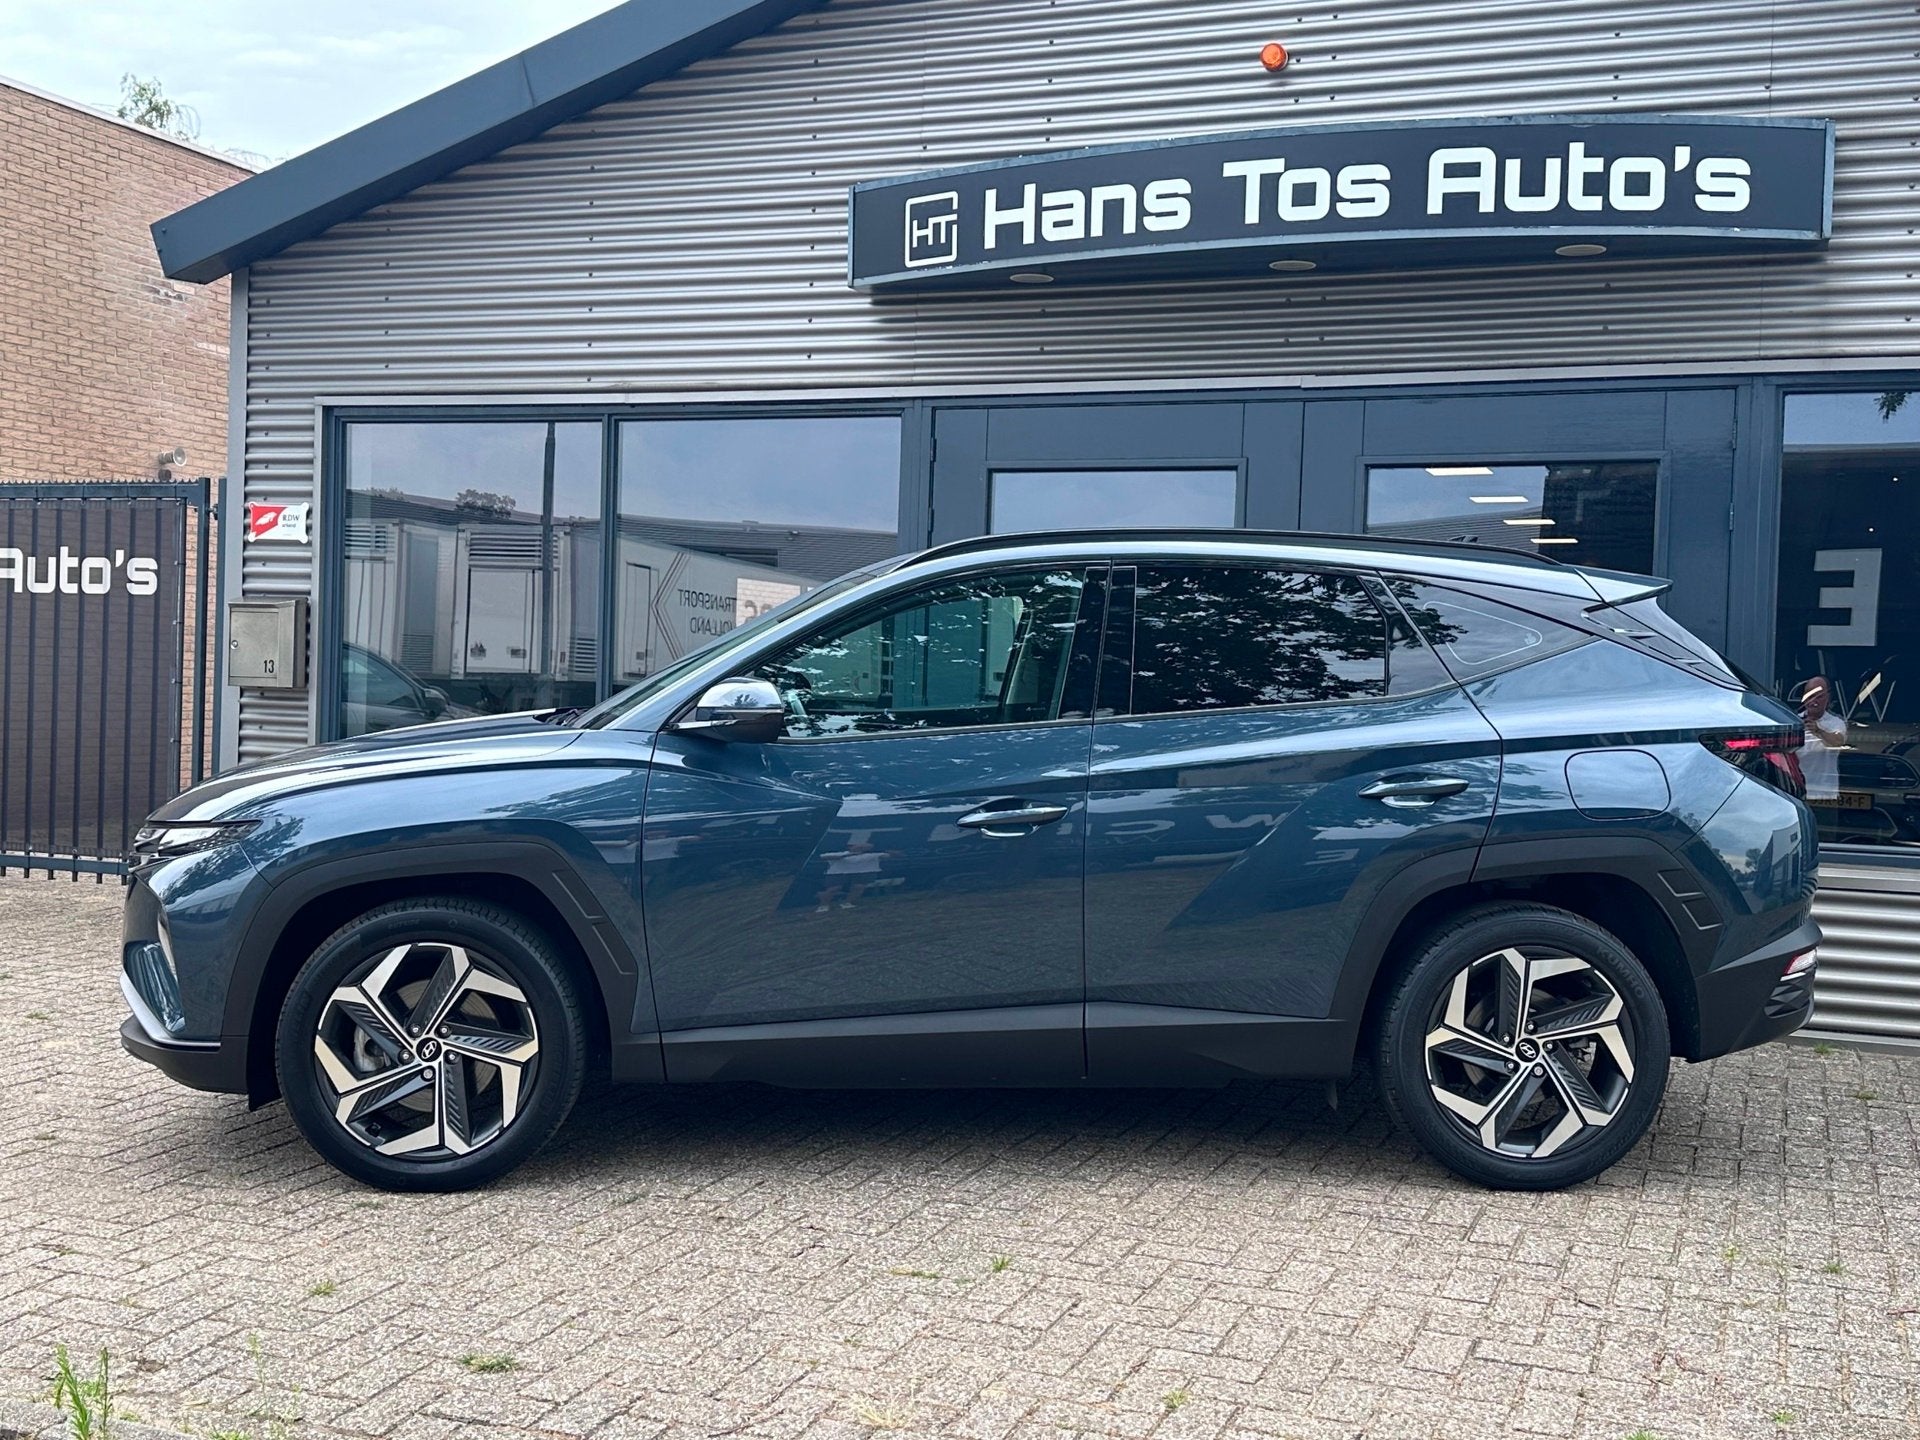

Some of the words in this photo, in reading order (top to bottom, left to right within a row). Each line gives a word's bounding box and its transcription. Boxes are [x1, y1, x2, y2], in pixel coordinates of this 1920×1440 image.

[984, 178, 1192, 250] Hans
[1222, 157, 1391, 225] Tos
[1426, 141, 1751, 215] Auto's
[282, 514, 300, 522] RDW
[0, 545, 158, 595] Auto's
[263, 659, 275, 674] 13
[1596, 945, 1645, 999] KUMHO
